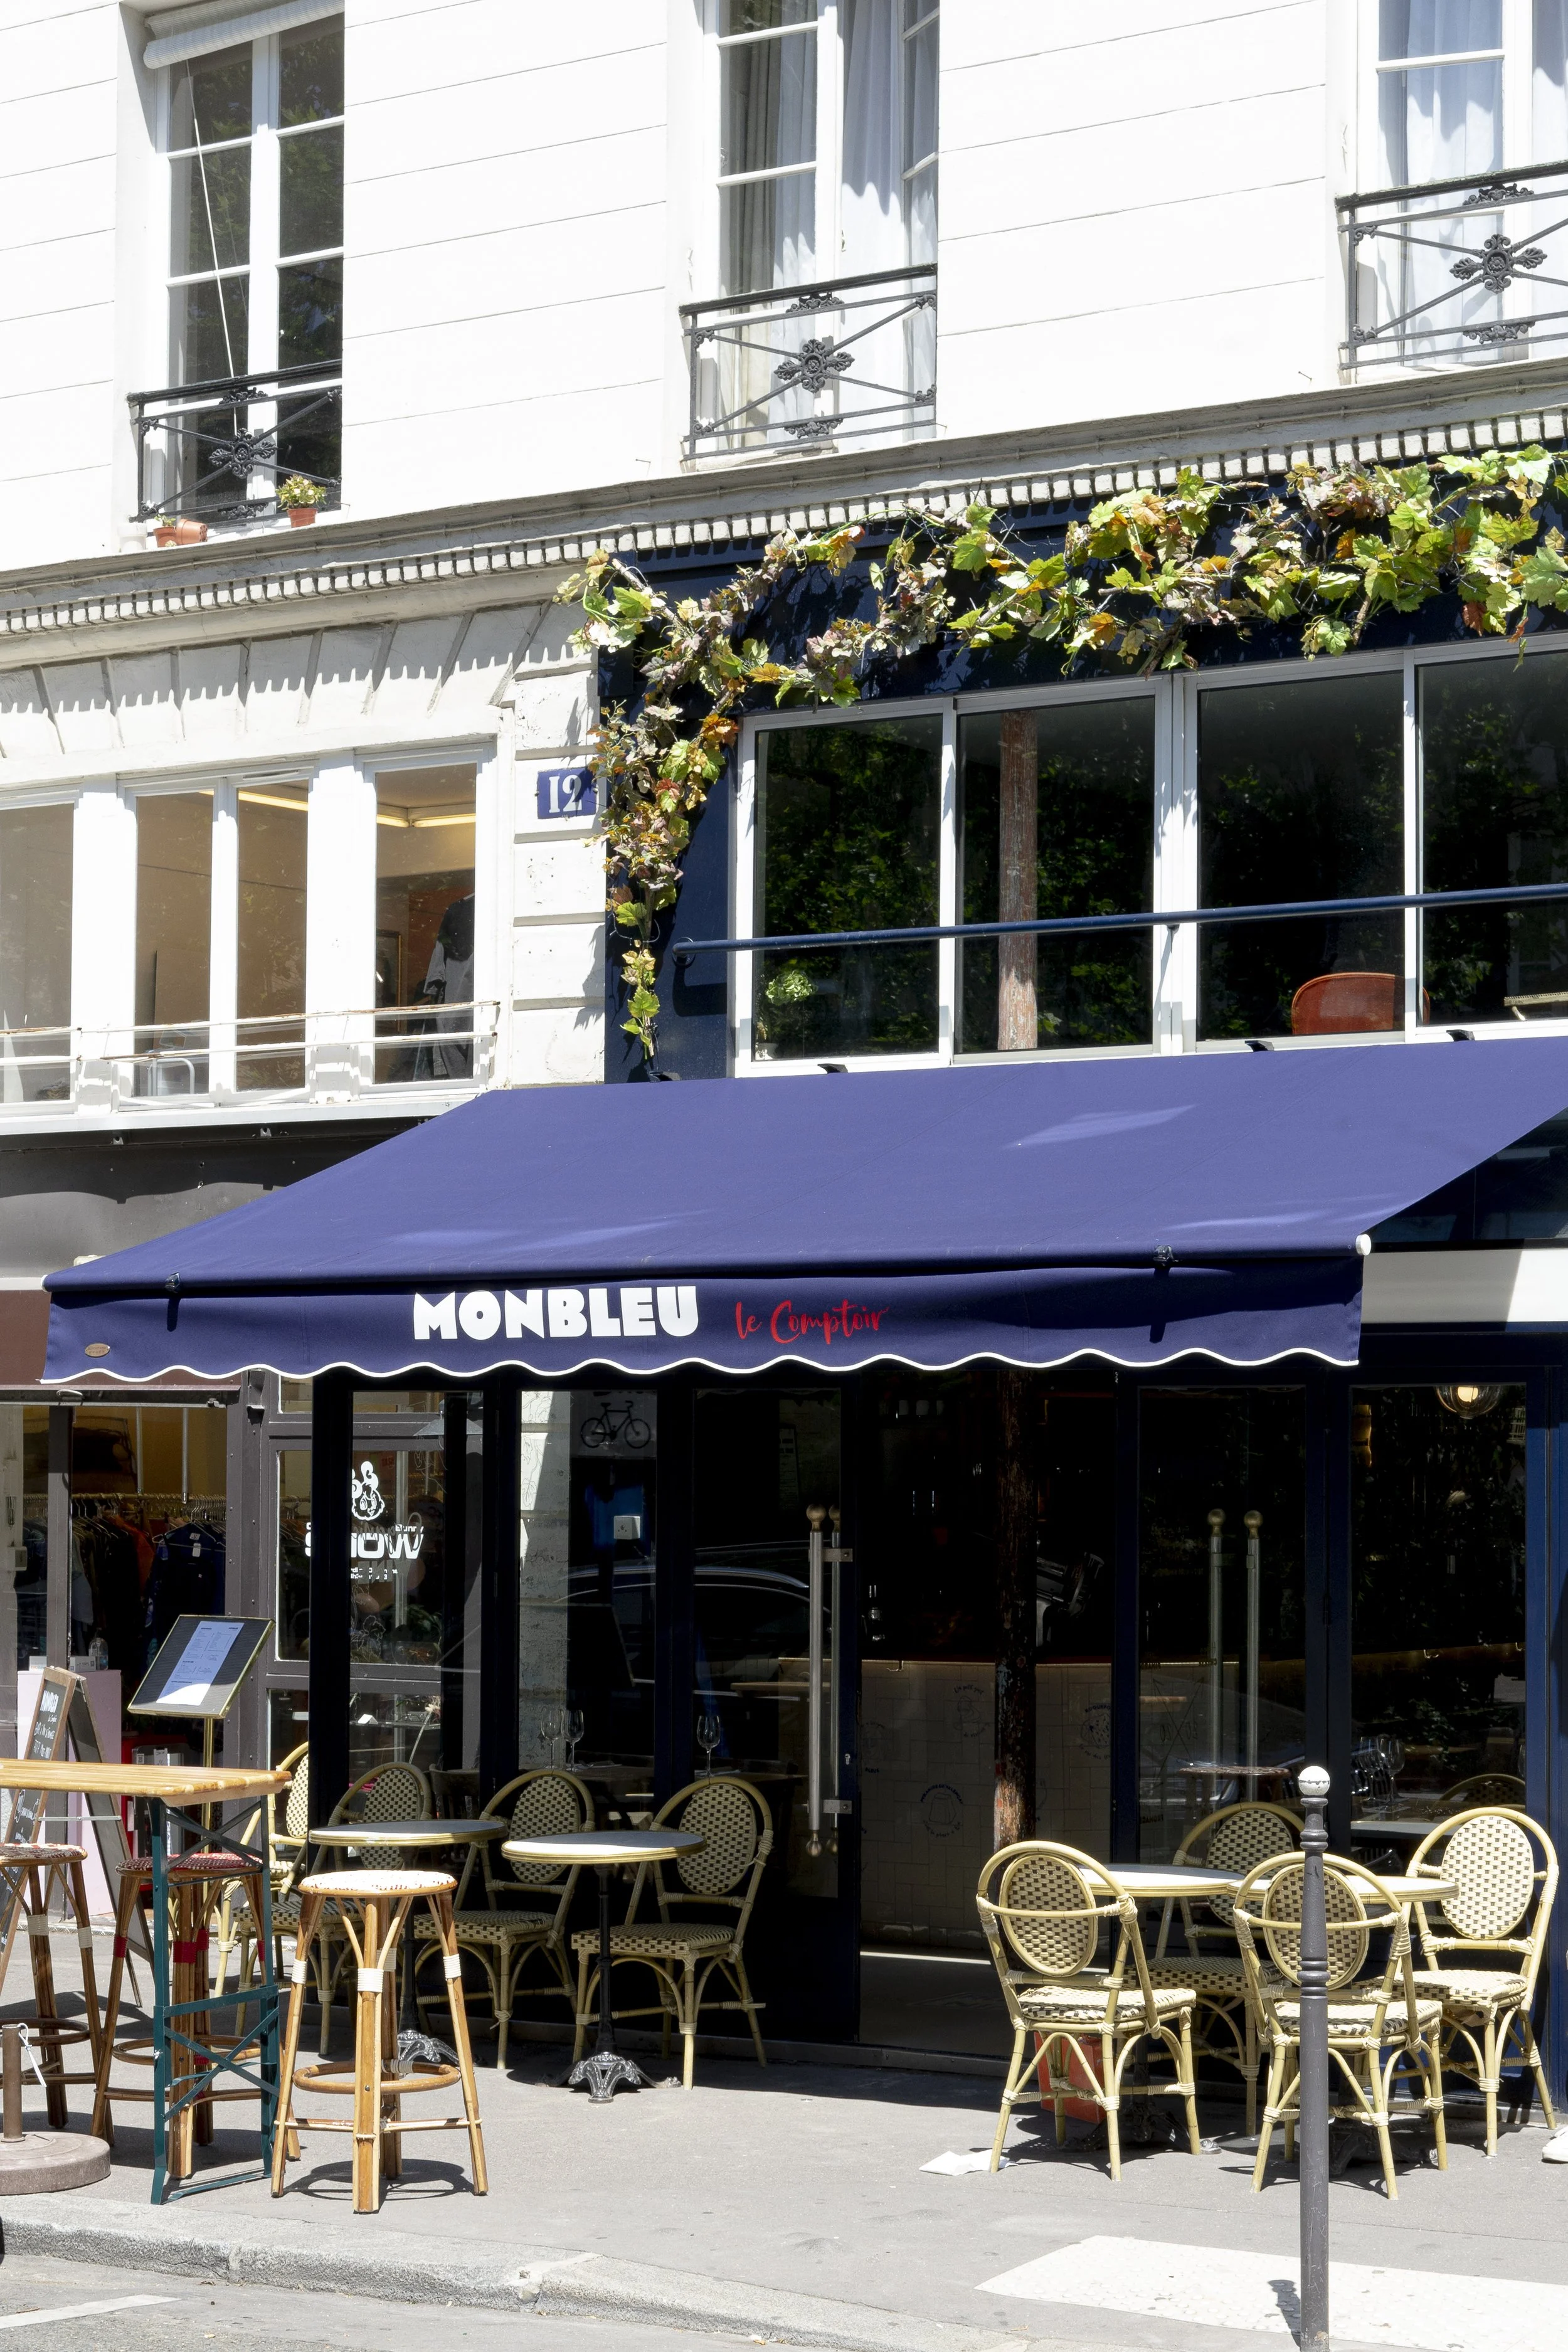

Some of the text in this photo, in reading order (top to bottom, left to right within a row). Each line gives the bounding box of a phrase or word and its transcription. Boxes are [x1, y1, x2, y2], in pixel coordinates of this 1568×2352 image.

[549, 775, 582, 813] 12
[413, 1286, 699, 1340] MONBLEU
[770, 1299, 889, 1345] Comptoir
[1084, 1705, 1112, 1713] ROQUEFO
